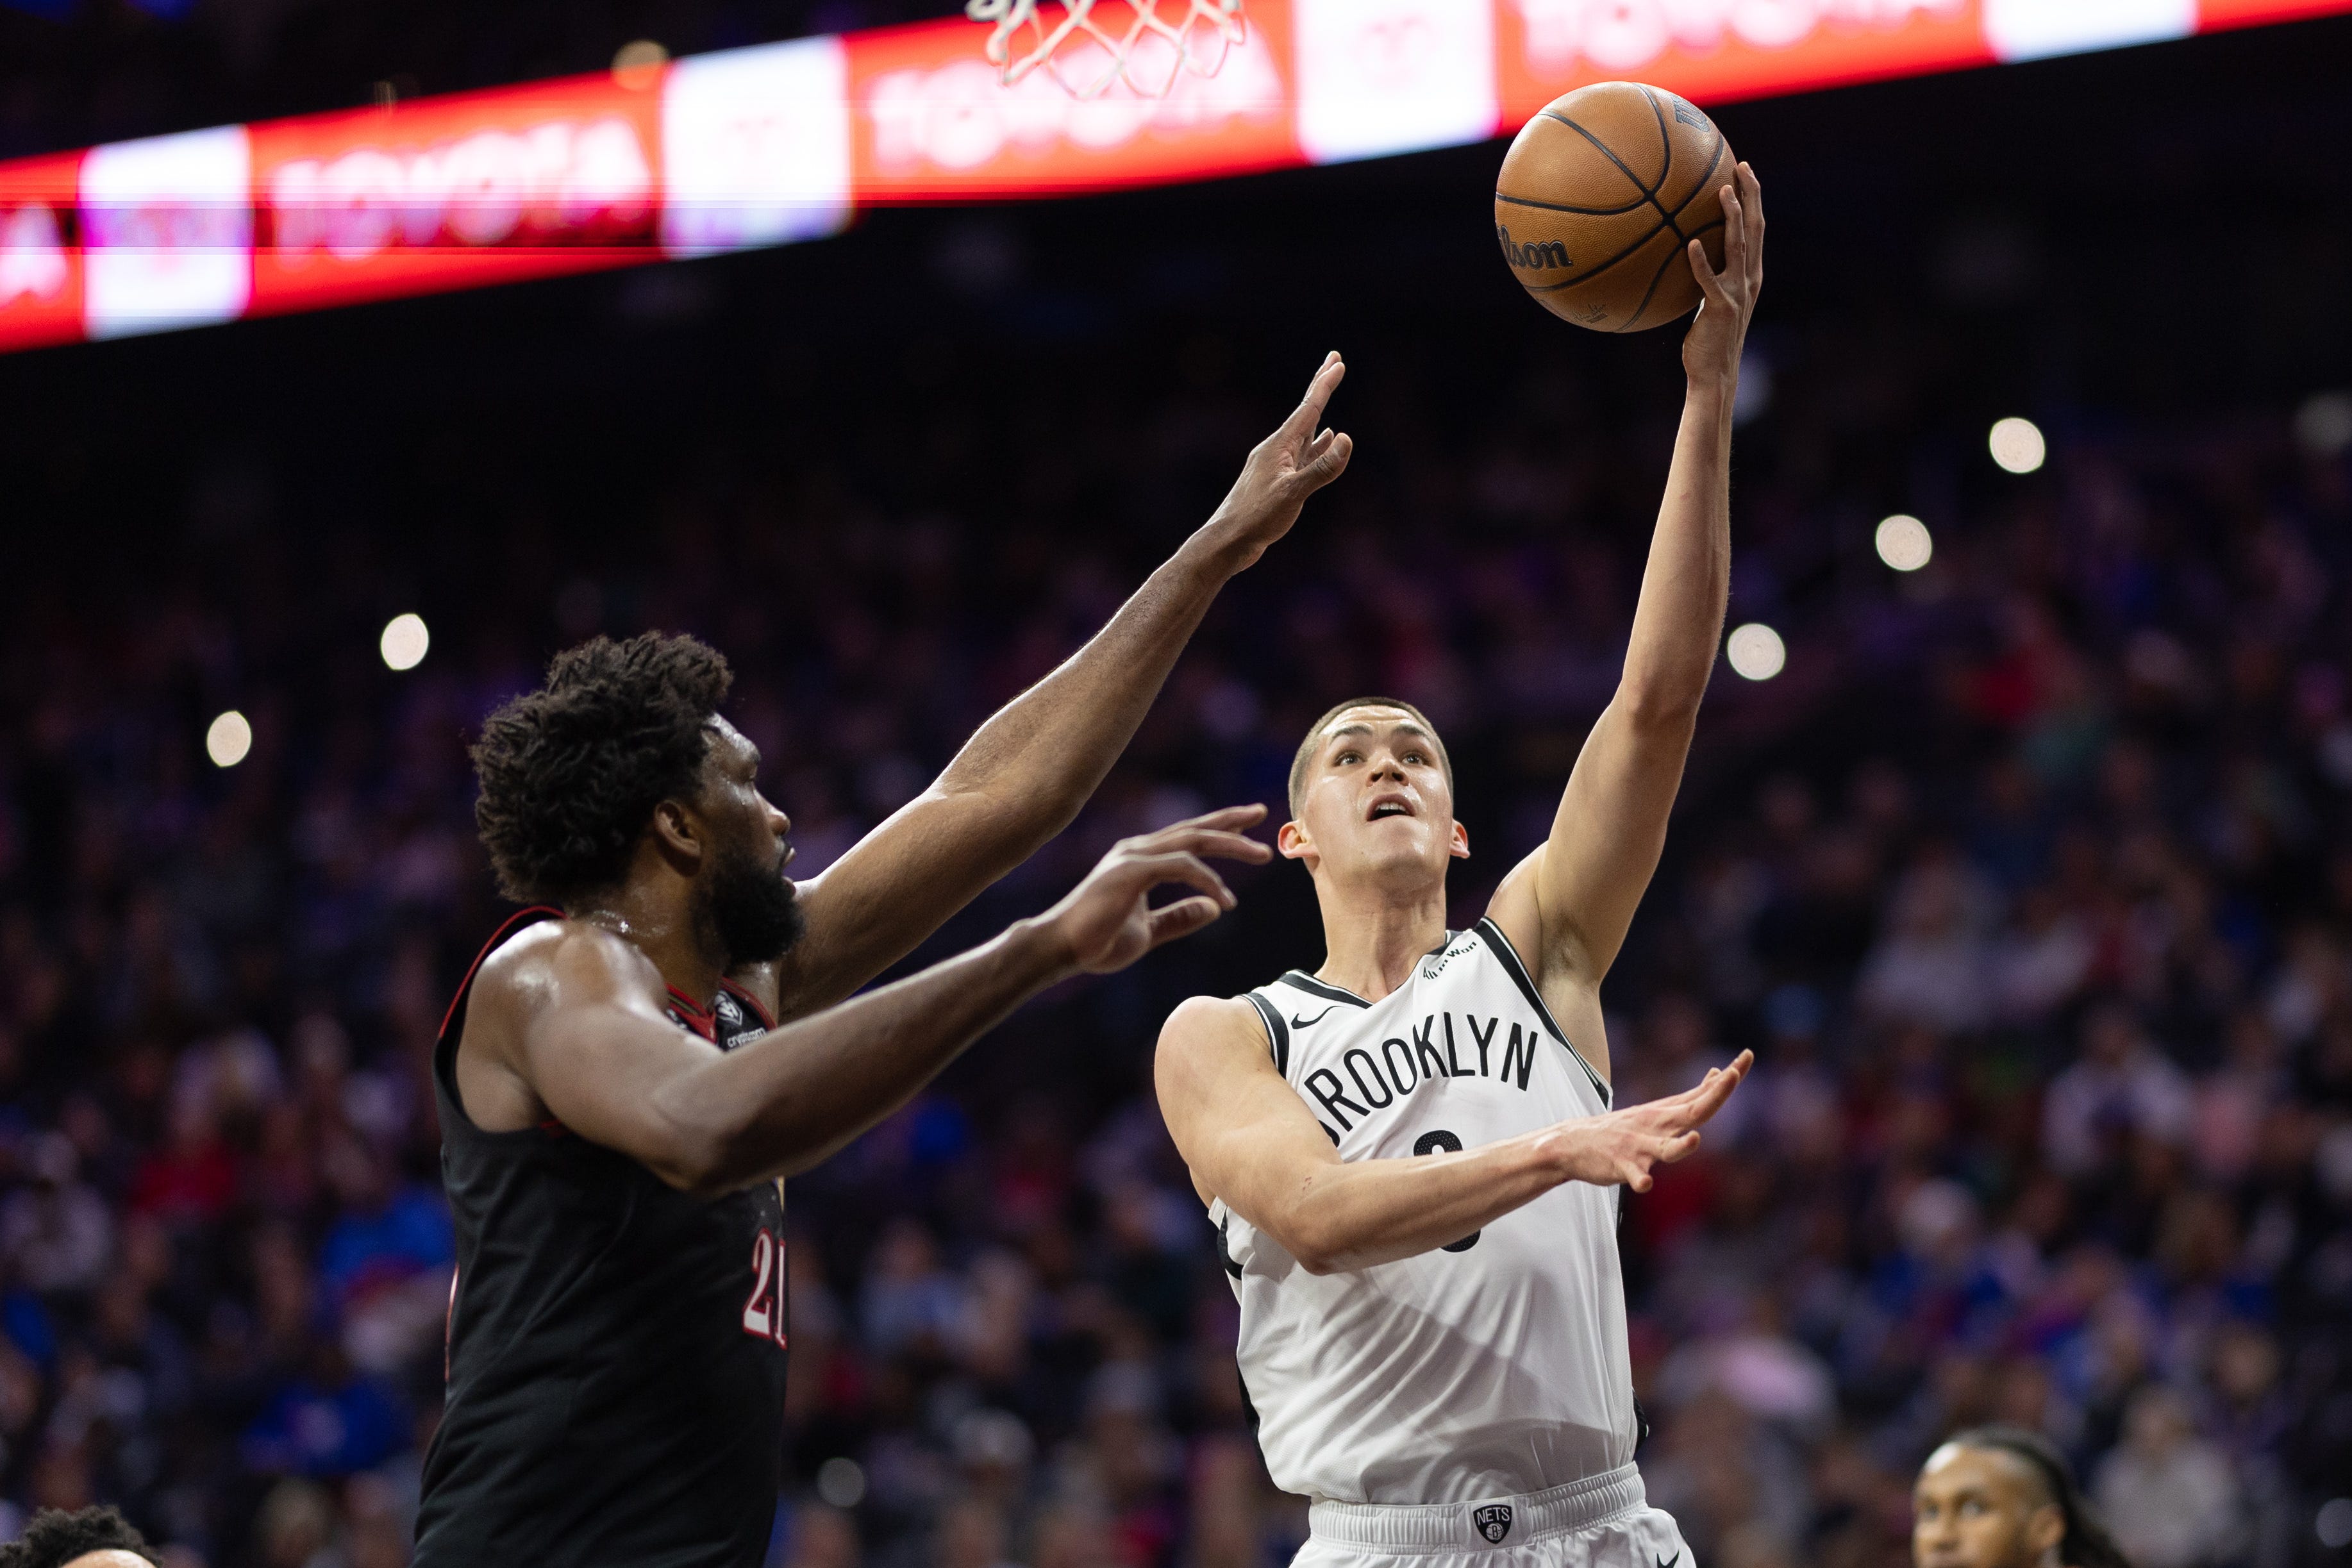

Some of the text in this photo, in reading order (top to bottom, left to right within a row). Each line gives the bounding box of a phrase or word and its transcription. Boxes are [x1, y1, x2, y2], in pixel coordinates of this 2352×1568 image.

[1304, 1012, 1539, 1148] ROOKLYN
[743, 1227, 787, 1349] 21
[1476, 1507, 1510, 1525] NETS
